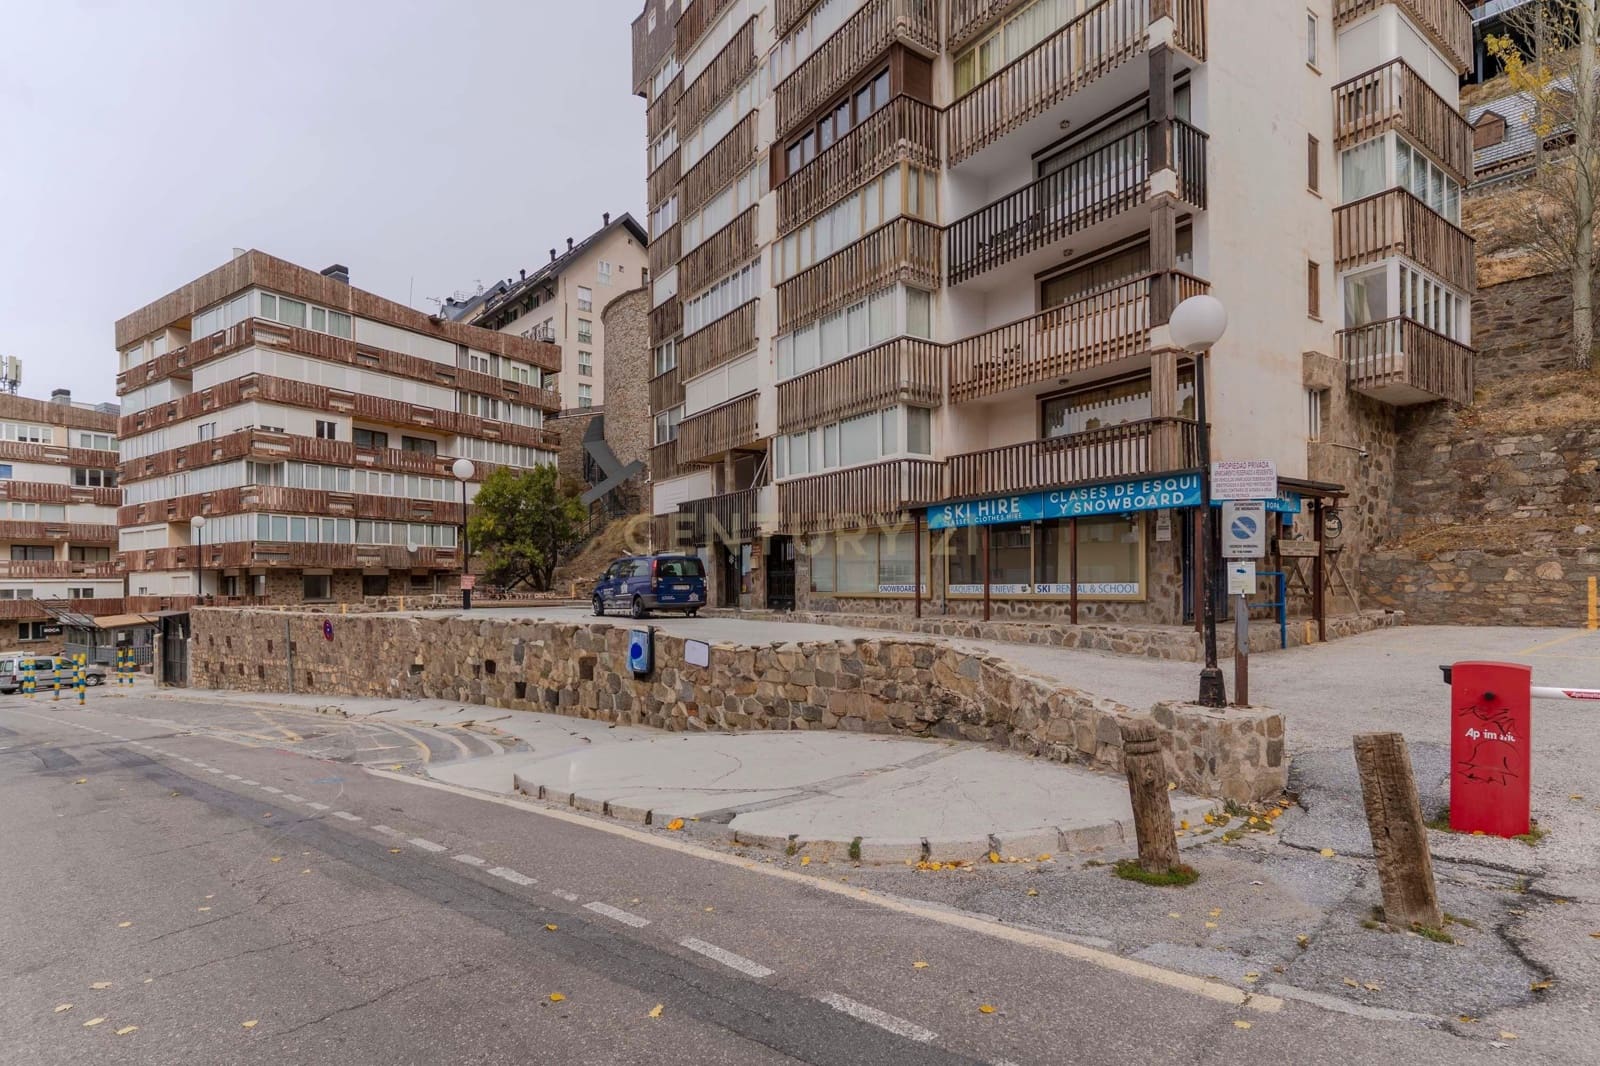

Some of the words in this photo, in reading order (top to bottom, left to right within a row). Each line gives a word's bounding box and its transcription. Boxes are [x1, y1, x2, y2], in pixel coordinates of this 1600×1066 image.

[1049, 486, 1107, 503] CLASES
[1114, 483, 1135, 497] DE
[1142, 476, 1197, 494] ESQUI
[943, 503, 970, 519] SKI
[978, 497, 1020, 516] HIRE
[1060, 503, 1068, 514] Y
[1073, 492, 1184, 513] SNOWBOARD
[974, 515, 1004, 523] CLOTHES
[1037, 584, 1051, 593] SKI
[1055, 584, 1087, 593] RENAL
[1089, 584, 1096, 593] &
[1098, 583, 1137, 593] SCHOOL
